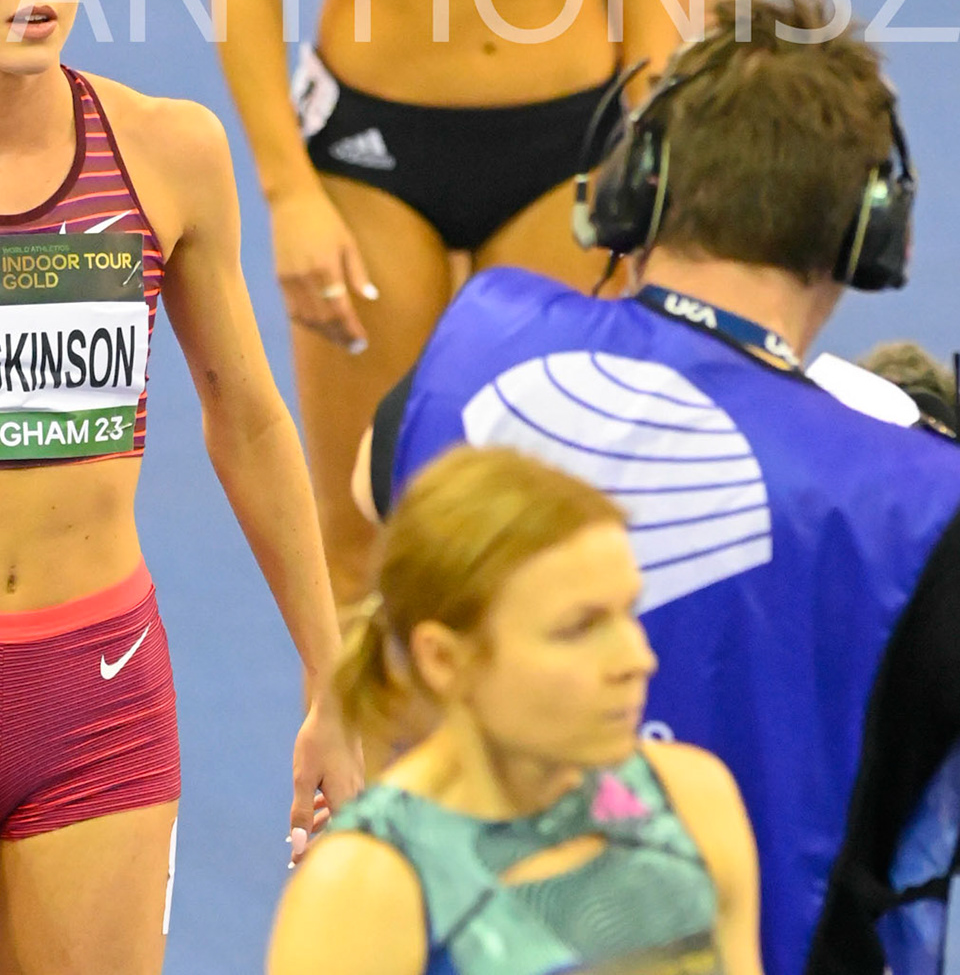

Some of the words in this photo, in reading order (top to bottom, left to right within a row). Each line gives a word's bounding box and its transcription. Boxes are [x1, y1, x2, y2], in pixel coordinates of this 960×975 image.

[2, 254, 80, 271] INDOOR
[84, 252, 133, 270] TOUR
[2, 273, 59, 289] GOLD
[95, 416, 125, 443] 23
